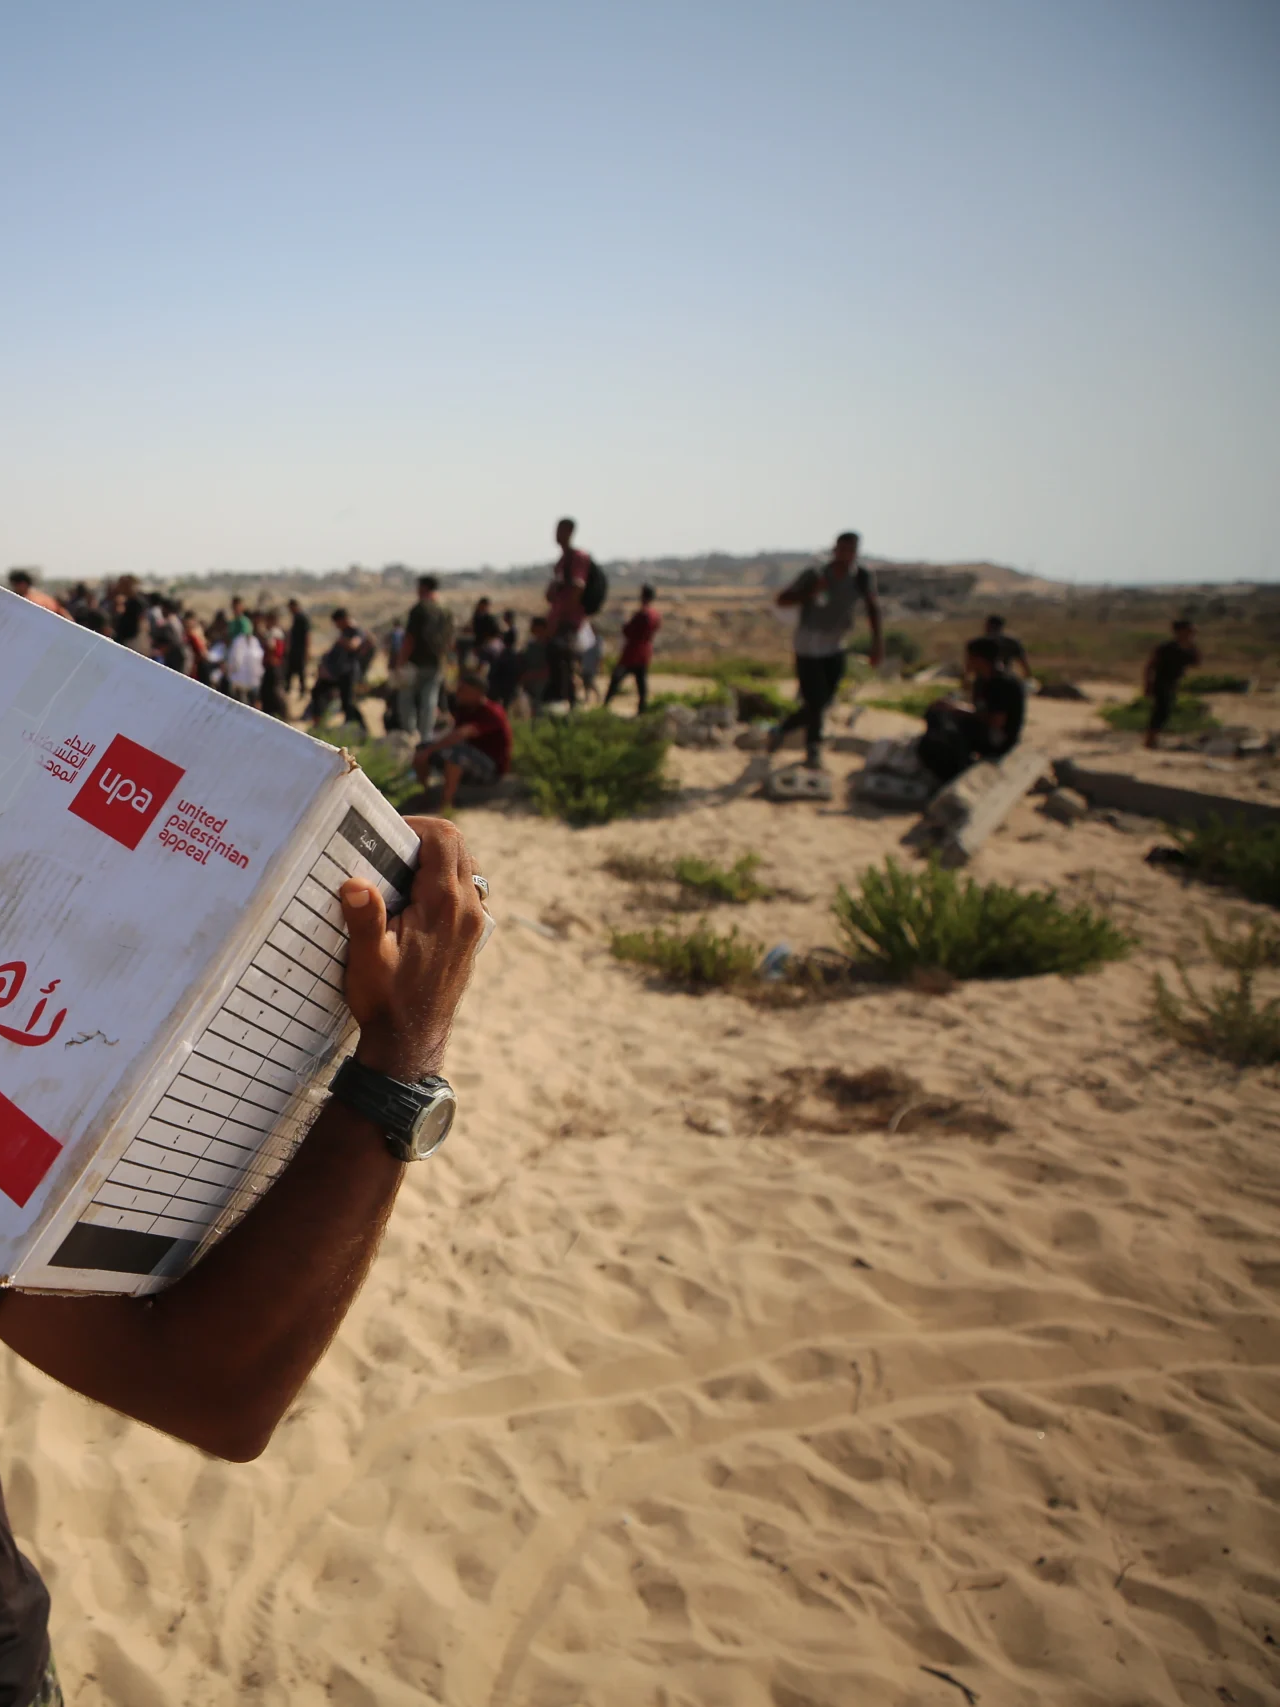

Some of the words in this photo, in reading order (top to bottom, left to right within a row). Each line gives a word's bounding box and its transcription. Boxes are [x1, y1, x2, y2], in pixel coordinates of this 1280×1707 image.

[64, 734, 96, 757] النداء
[98, 767, 153, 814] upa
[177, 799, 228, 833] united
[158, 828, 213, 865] appeal
[165, 814, 250, 869] palestinian
